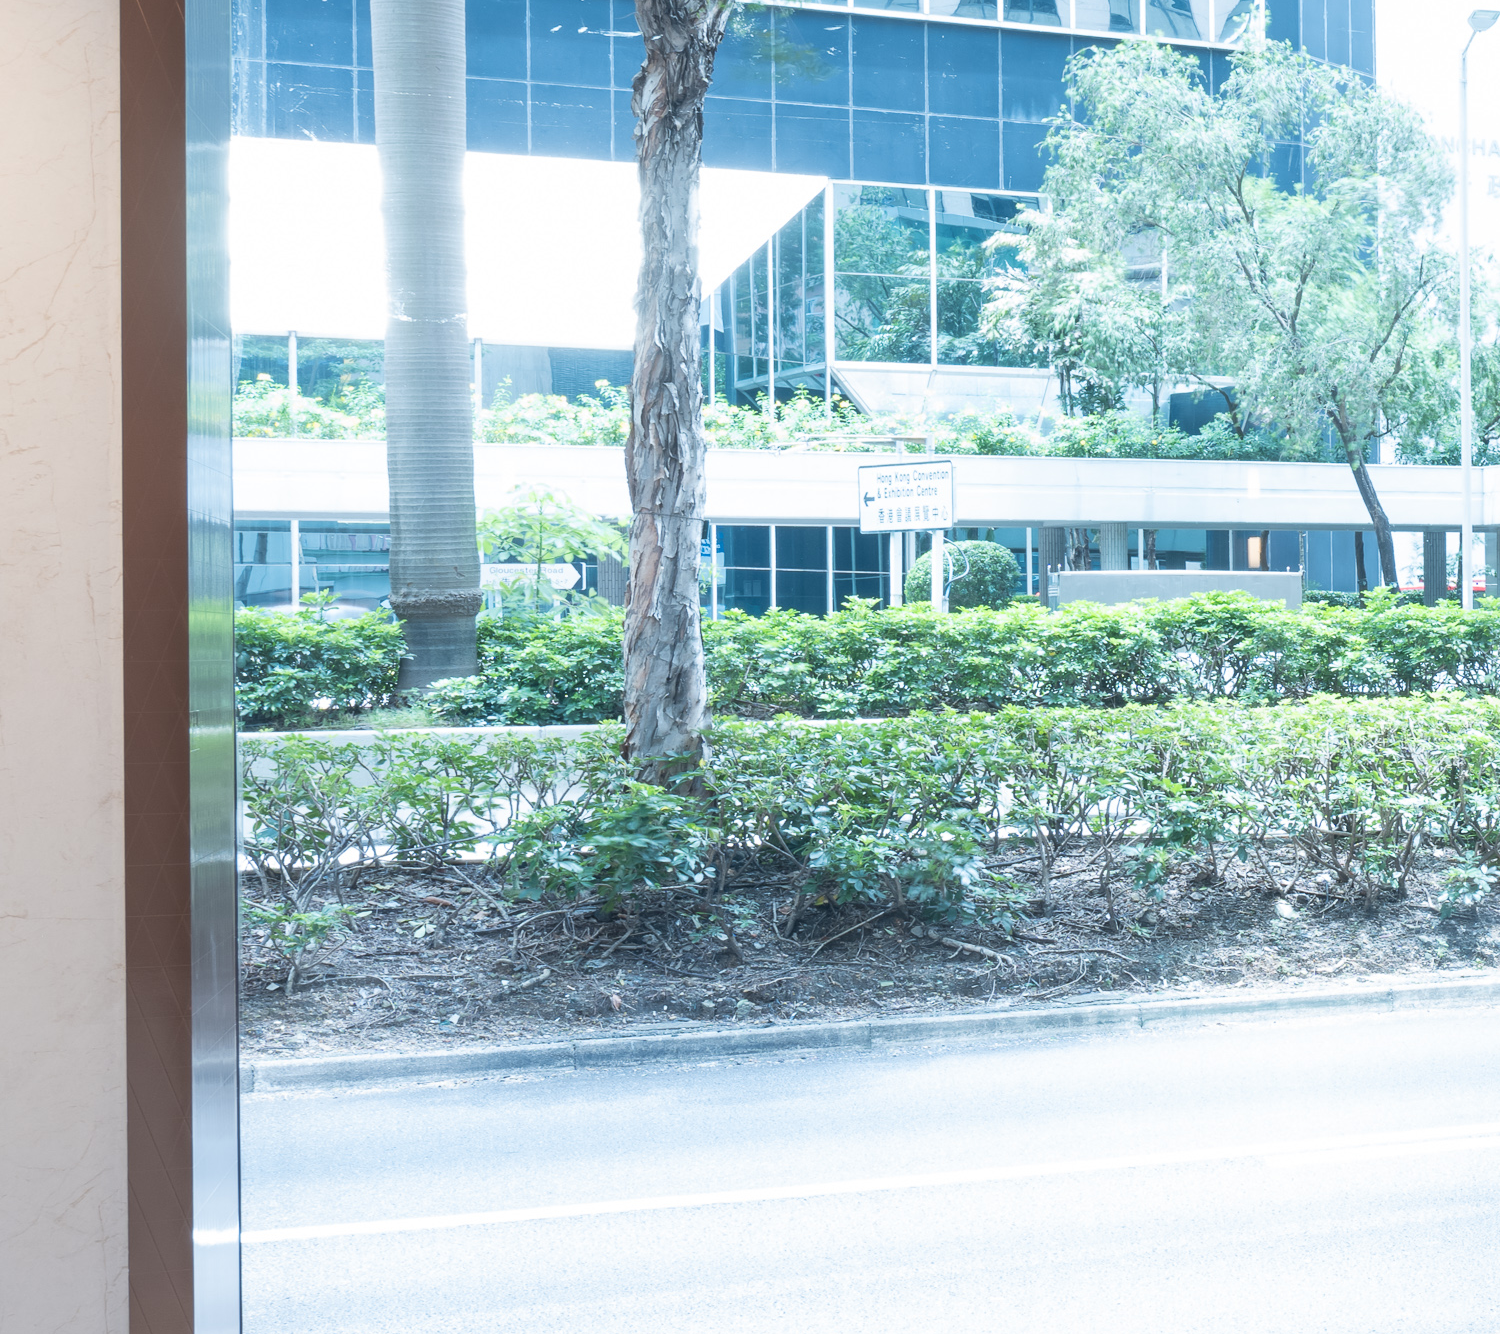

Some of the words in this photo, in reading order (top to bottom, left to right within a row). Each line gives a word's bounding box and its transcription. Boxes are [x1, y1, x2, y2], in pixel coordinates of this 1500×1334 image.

[877, 472, 892, 485] Hong
[894, 471, 910, 484] Kong
[912, 469, 949, 481] Convention
[884, 486, 914, 498] Exhibition
[917, 485, 938, 496] Centre
[489, 566, 538, 574] Gloucester
